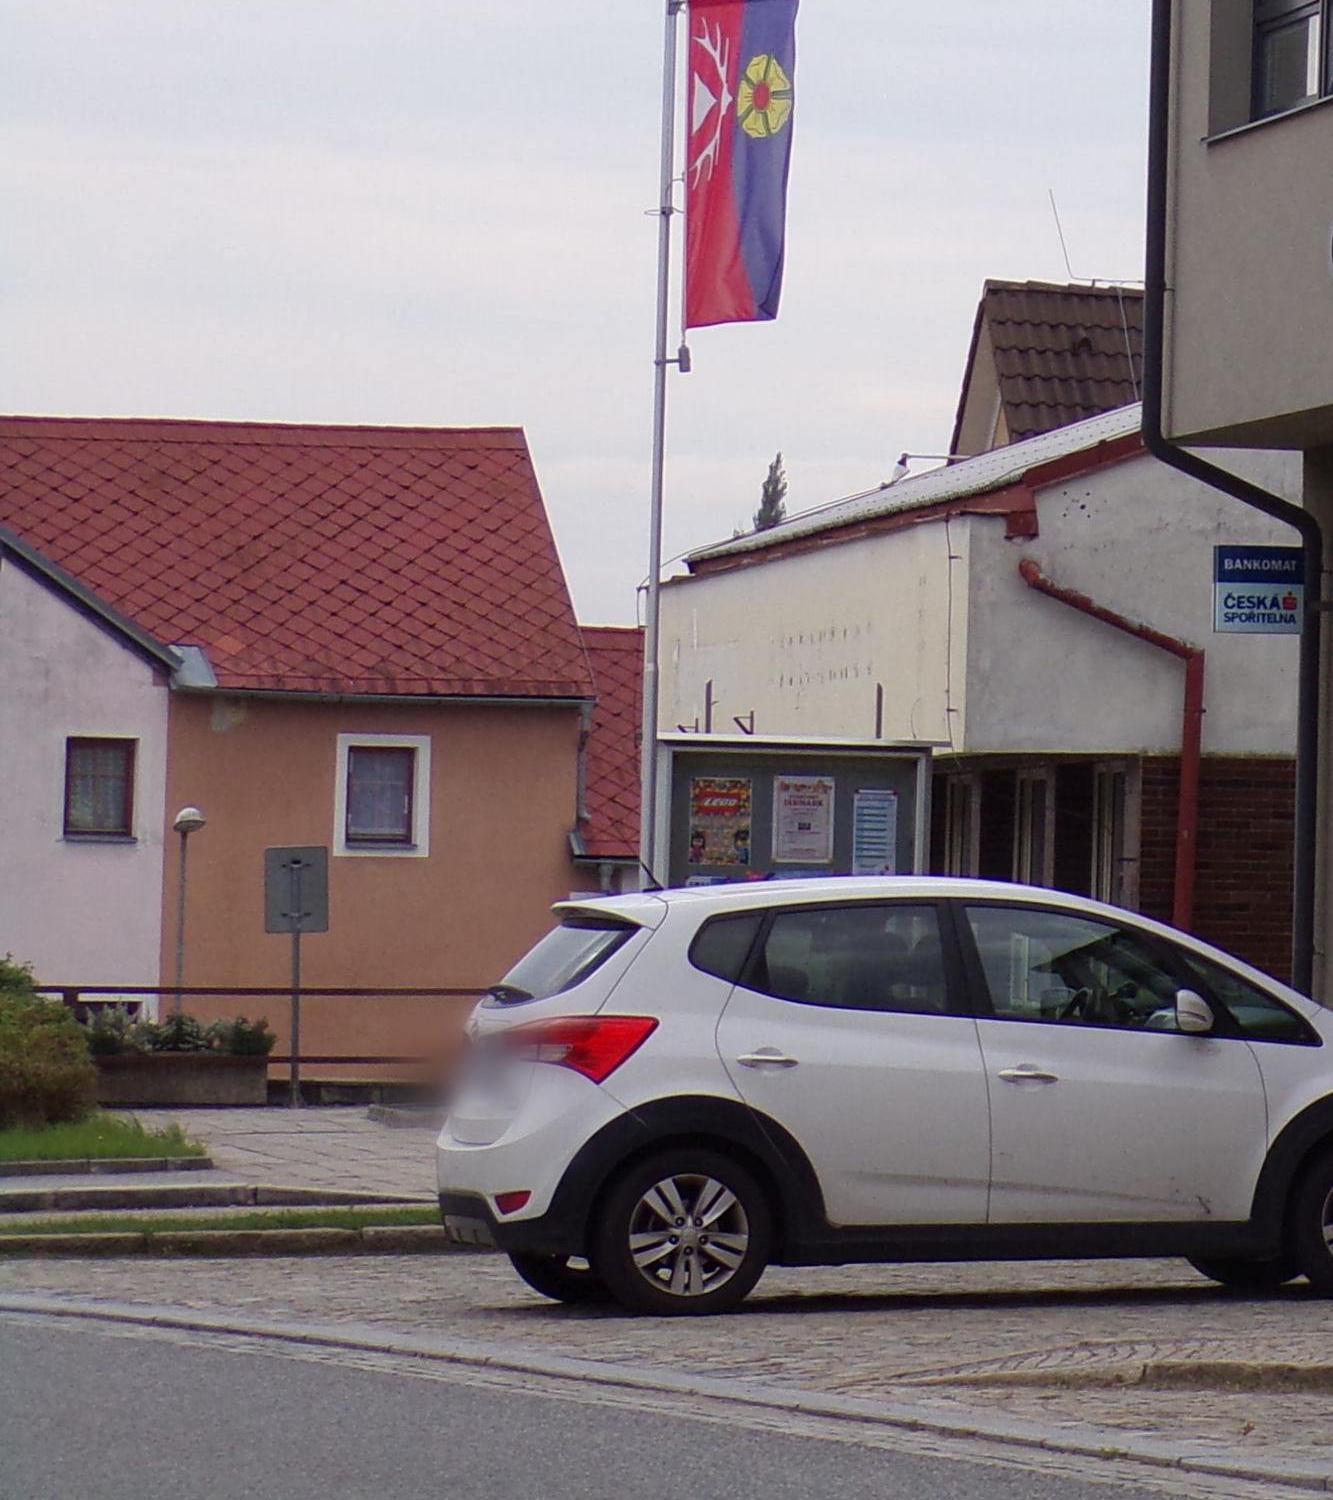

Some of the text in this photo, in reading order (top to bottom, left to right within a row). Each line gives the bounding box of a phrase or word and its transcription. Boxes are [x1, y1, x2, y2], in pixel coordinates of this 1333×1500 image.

[1223, 558, 1297, 572] BANKOMAT
[1223, 592, 1282, 611] ČESKÁ
[1223, 610, 1297, 625] SPOŘITELNA
